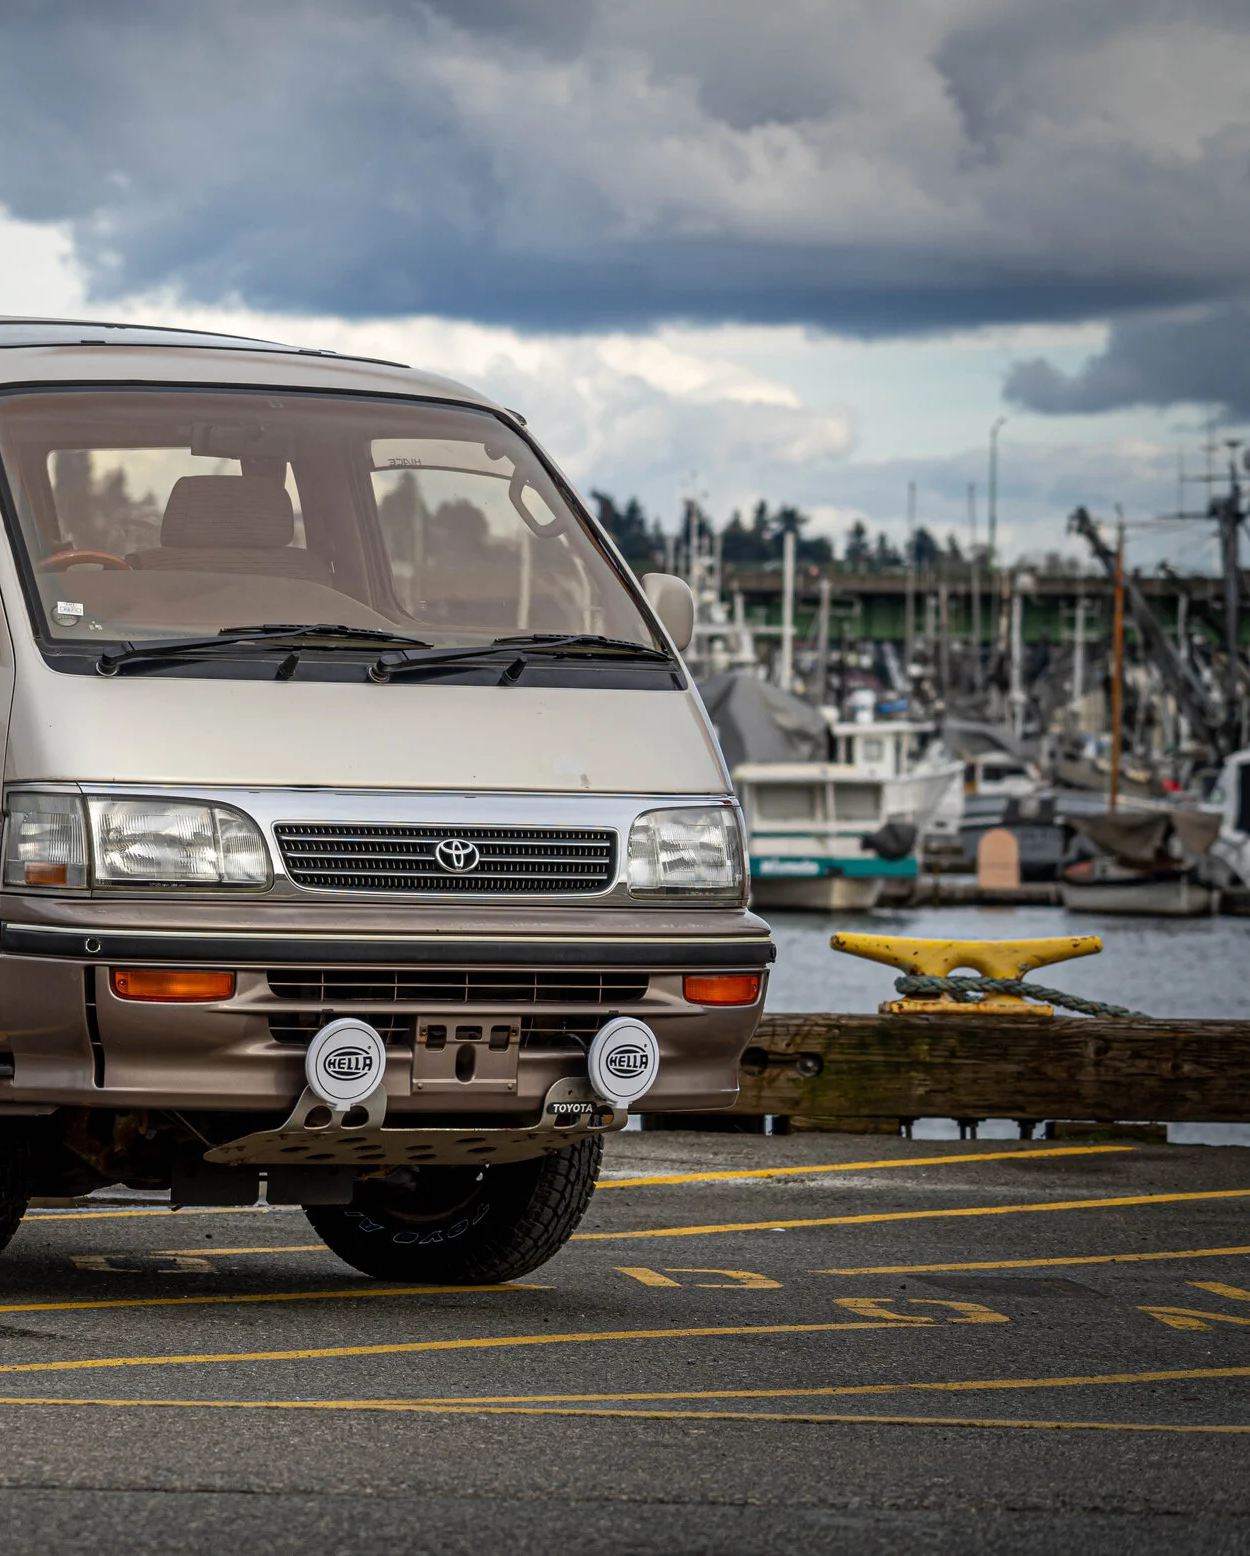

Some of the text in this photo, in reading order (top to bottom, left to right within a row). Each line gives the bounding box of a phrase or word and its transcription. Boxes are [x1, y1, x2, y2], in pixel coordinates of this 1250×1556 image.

[327, 1056, 373, 1072] HELLA
[609, 1054, 649, 1070] HELLA
[553, 1103, 593, 1113] TOYOTA
[392, 1203, 490, 1245] TOYO
